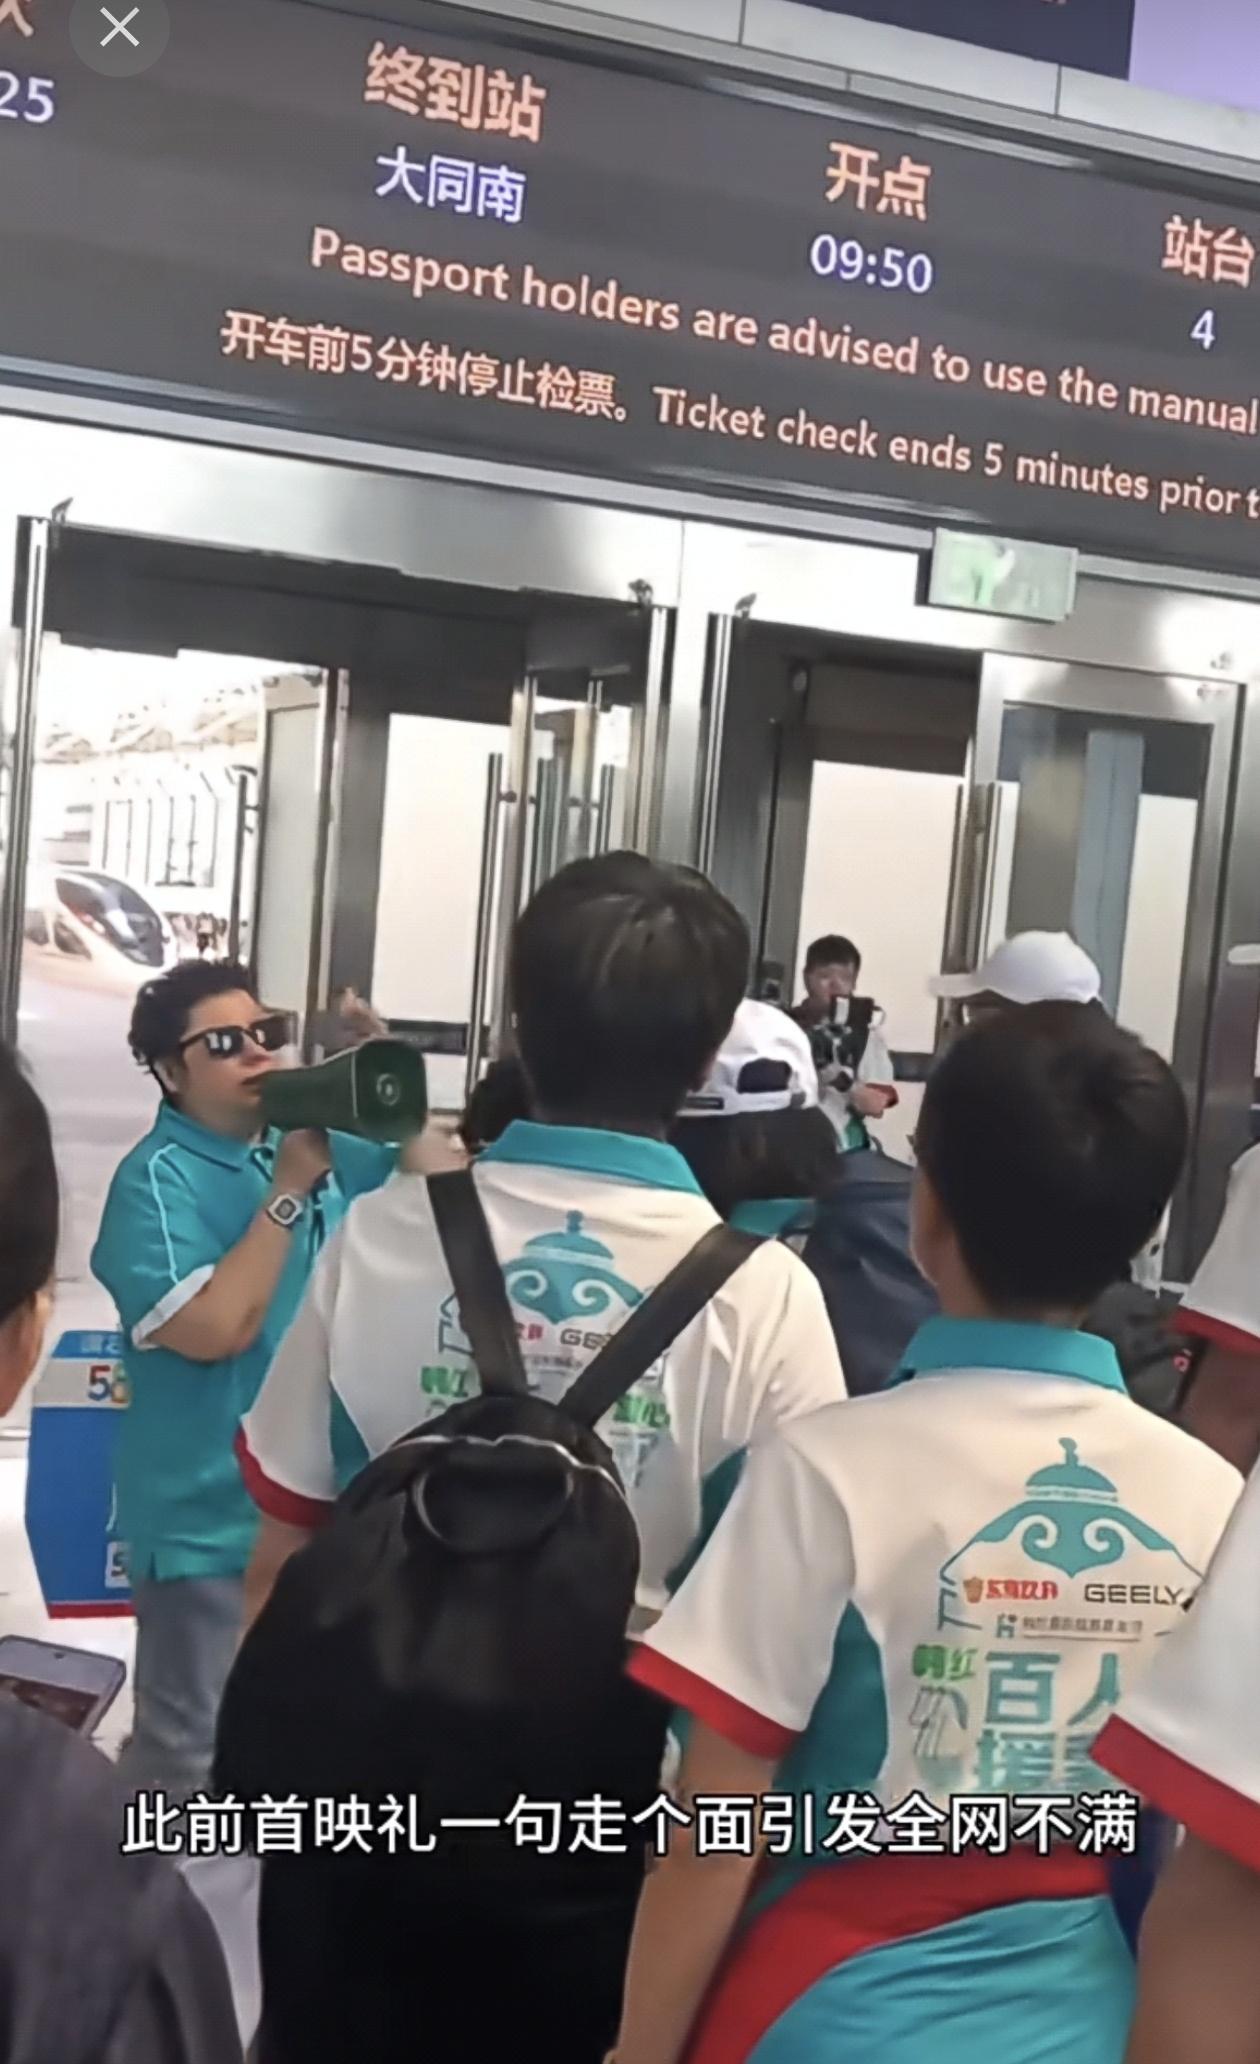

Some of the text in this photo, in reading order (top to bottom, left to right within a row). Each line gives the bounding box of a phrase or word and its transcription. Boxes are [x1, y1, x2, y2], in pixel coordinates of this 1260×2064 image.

[364, 41, 546, 143] 终到站
[375, 146, 526, 223] 大同南
[825, 141, 931, 220] 开点
[810, 234, 933, 293] 09:50
[1161, 214, 1255, 288] 站台
[311, 227, 1258, 434] Passport holders are advised to use the manual
[1191, 310, 1215, 350] 4
[220, 309, 628, 422] 开车前5分钟停止检票。
[653, 386, 765, 438] Ticket
[777, 409, 878, 458] check
[889, 433, 971, 472] ends
[984, 443, 1004, 475] 5
[1016, 451, 1149, 500] minutes
[1160, 475, 1241, 514] prior
[1084, 1583, 1184, 1605] GEELY
